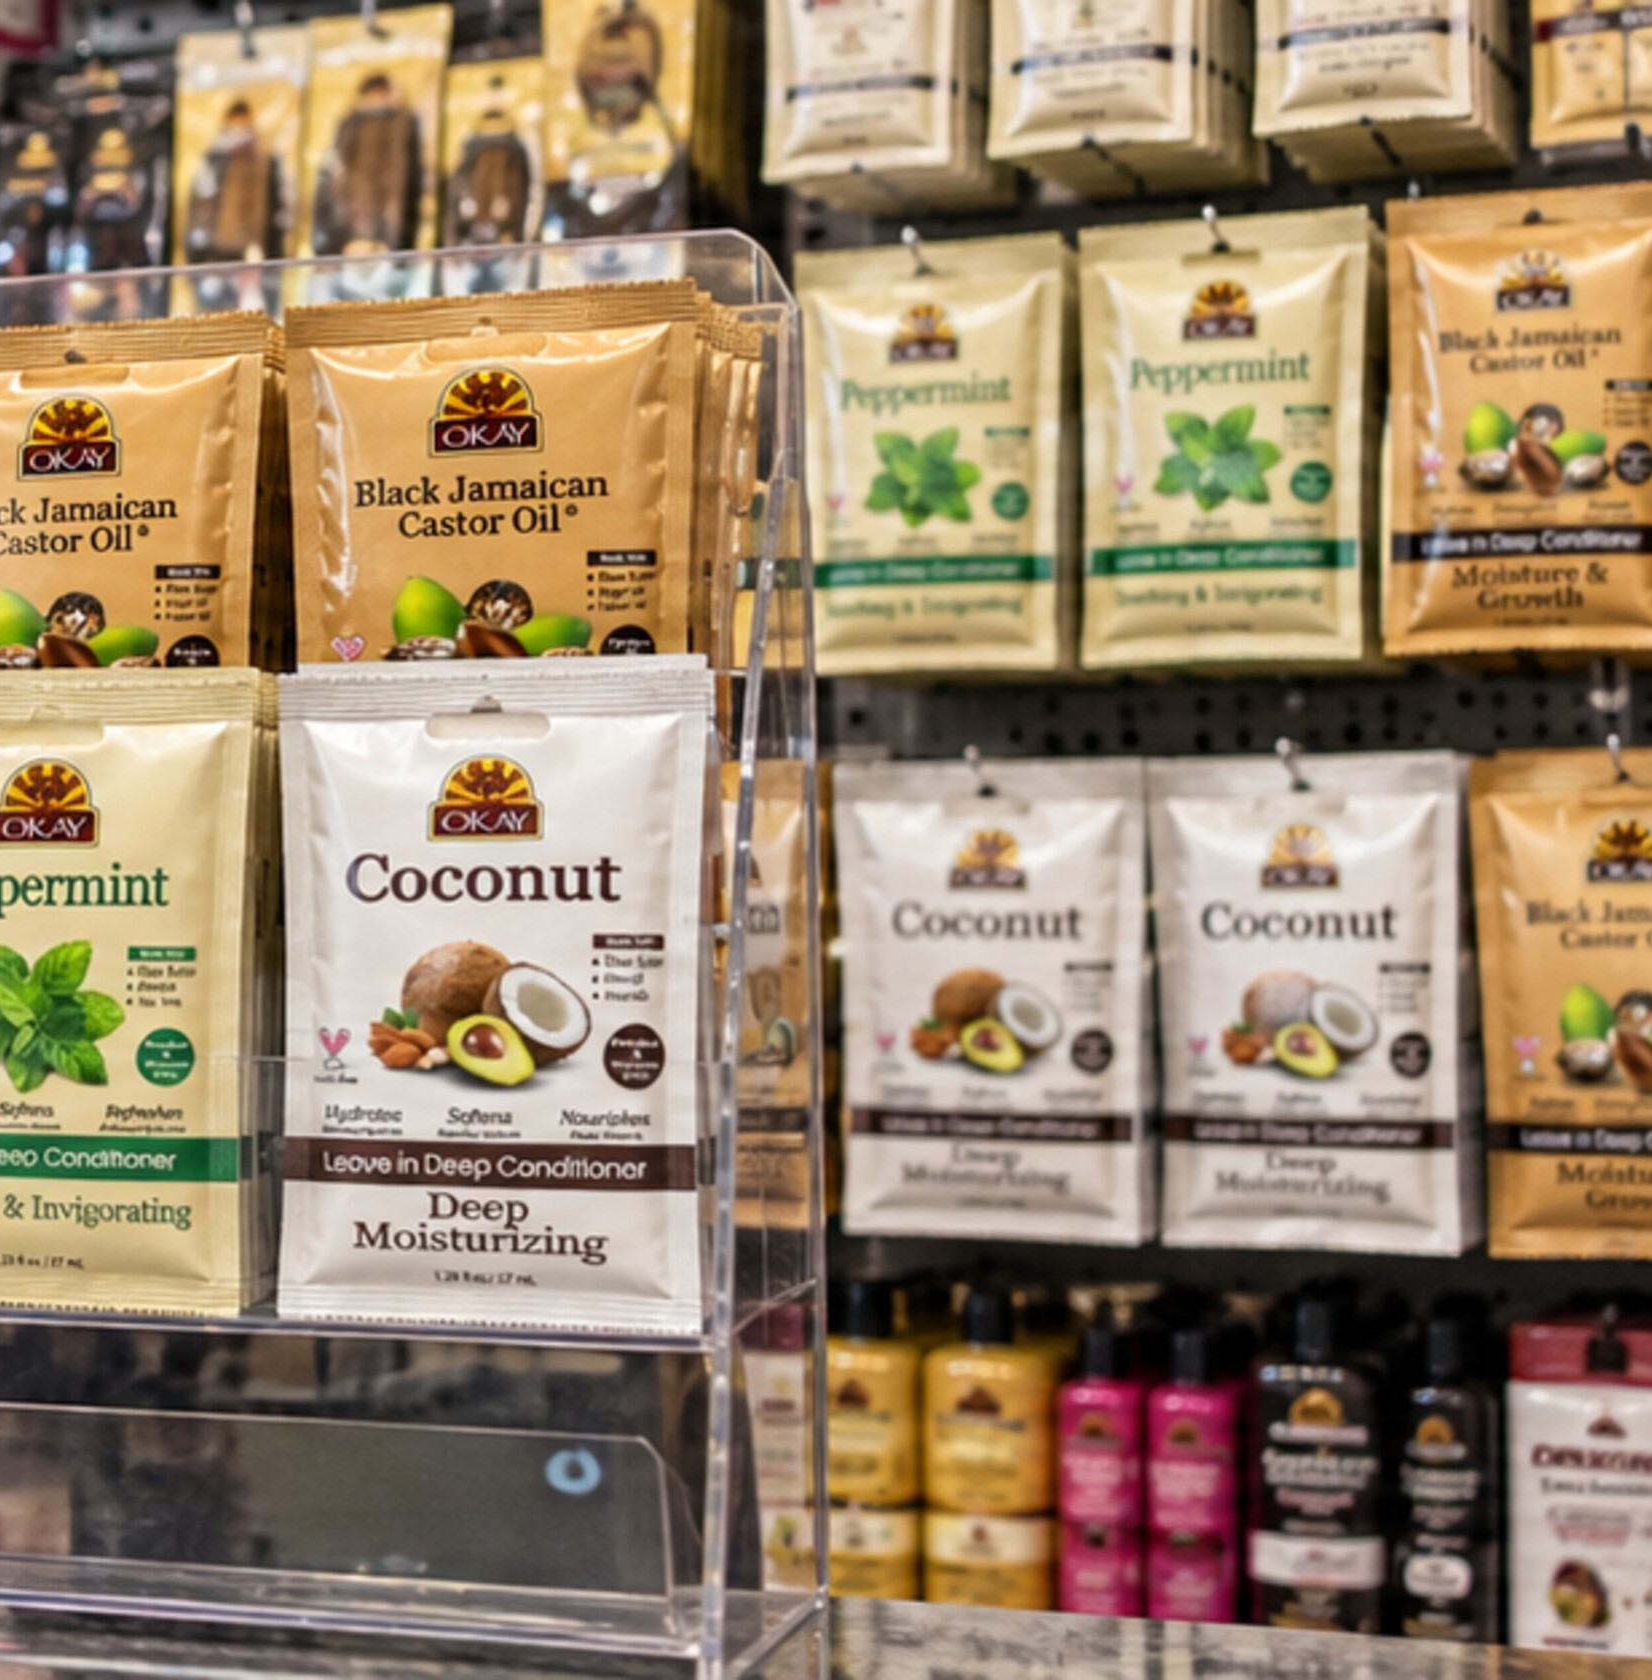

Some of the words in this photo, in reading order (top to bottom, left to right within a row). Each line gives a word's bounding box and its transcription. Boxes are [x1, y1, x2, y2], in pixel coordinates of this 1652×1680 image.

[1130, 347, 1310, 394] Peppermint
[840, 370, 1011, 415] Peppermint
[442, 422, 530, 448] OKAY
[28, 447, 111, 472] OKAY
[33, 493, 178, 523] Jamaican
[354, 476, 441, 508] Black
[448, 471, 610, 502] Jamaican
[398, 511, 505, 538] Castor
[1452, 563, 1580, 588] Moisture
[1, 817, 88, 839] OKAY
[440, 809, 530, 834] OKAY
[345, 853, 622, 902] Coconut
[892, 902, 1083, 941] Coconut
[1200, 902, 1397, 941] Coconut
[322, 1150, 393, 1175] Leave
[397, 1151, 420, 1175] in
[424, 1153, 492, 1181] Deep
[496, 1155, 648, 1182] Conditioner
[3, 1194, 26, 1220] &
[31, 1195, 193, 1231] Invigorating
[427, 1191, 530, 1230] Deep
[353, 1220, 609, 1267] Moisturizing
